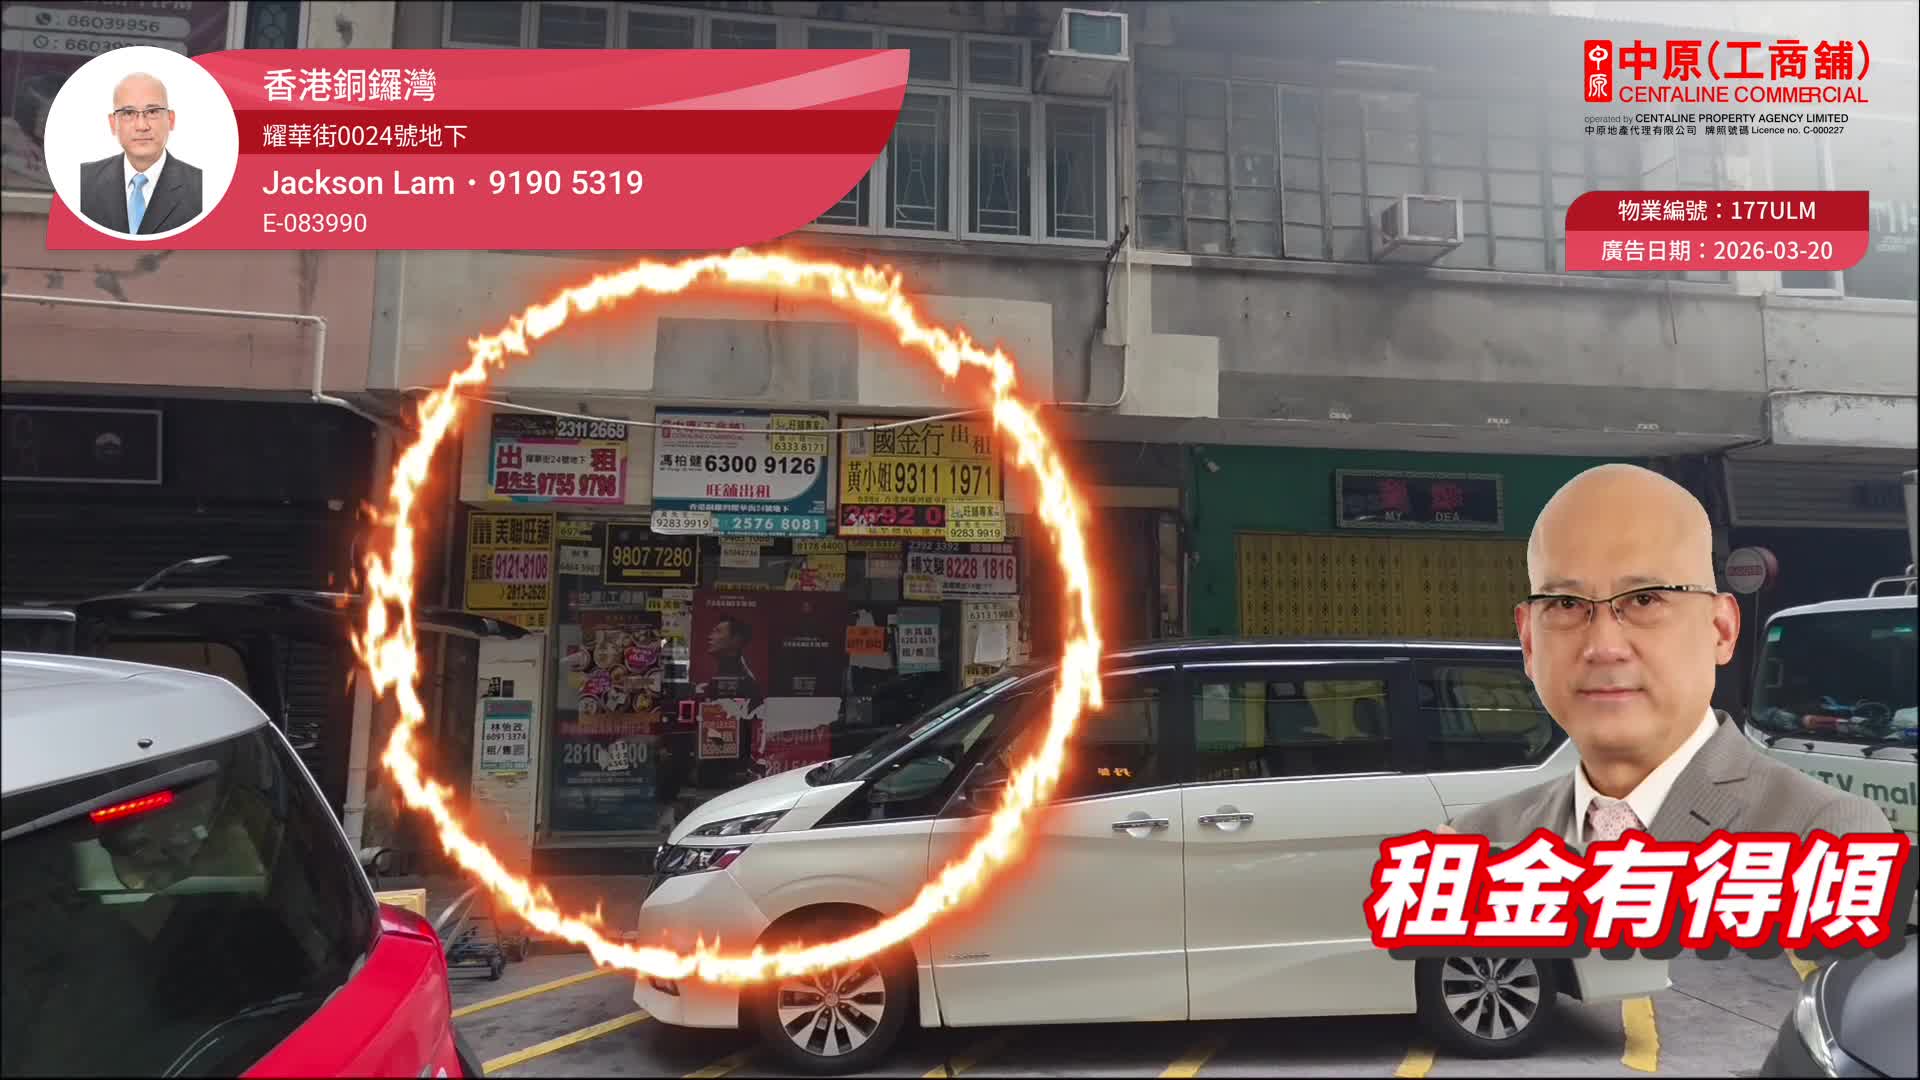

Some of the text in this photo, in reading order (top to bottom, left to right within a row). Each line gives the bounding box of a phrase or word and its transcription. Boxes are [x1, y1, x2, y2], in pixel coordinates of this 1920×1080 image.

[774, 443, 825, 453] 6333 8171
[873, 423, 944, 457] 國金行
[951, 424, 969, 444] 出
[497, 445, 522, 469] 出
[591, 448, 616, 472] 租
[705, 456, 756, 473] 6300
[764, 457, 816, 475] 9126
[848, 460, 992, 497] 黃小姐 9311 1971
[656, 518, 710, 529] 9283 9919
[733, 517, 822, 531] 2576 8081
[1385, 511, 1403, 522] MY
[950, 528, 975, 537] 9283
[977, 528, 1001, 538] 9919
[495, 554, 548, 580] 9121-8108
[612, 546, 692, 568] 9807 7280
[946, 558, 977, 579] 8228
[983, 559, 1015, 580] 1816
